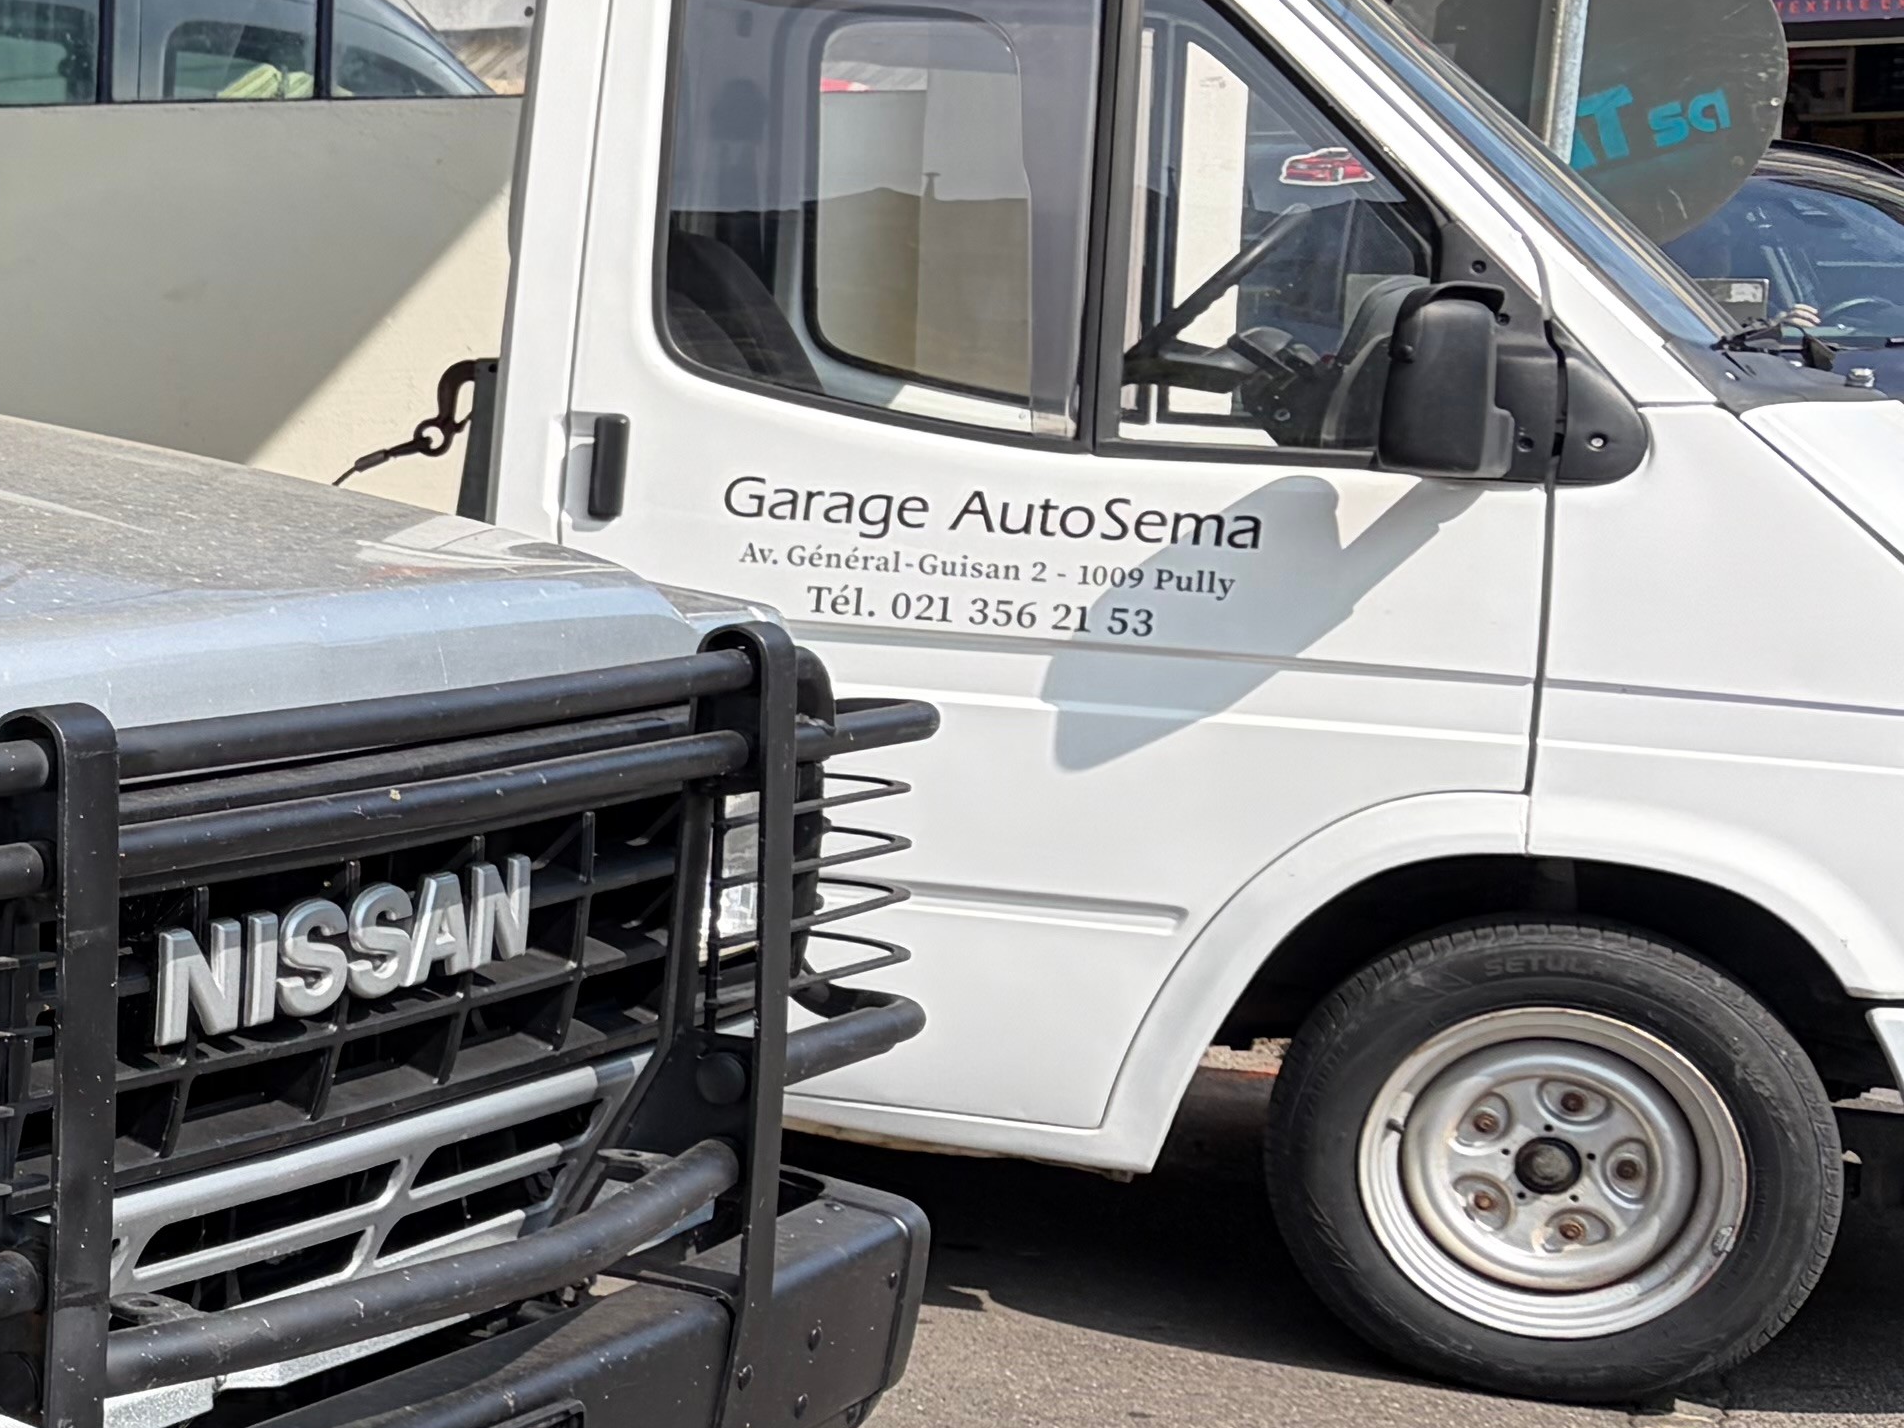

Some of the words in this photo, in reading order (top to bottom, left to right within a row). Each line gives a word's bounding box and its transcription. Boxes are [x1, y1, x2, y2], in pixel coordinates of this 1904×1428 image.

[723, 476, 930, 540] Garage
[948, 489, 1263, 551] AutoSema
[738, 541, 779, 567] Av.
[786, 544, 1021, 582] Général-Guisan
[1031, 560, 1048, 583] 2
[1078, 564, 1144, 590] 1009
[1153, 568, 1236, 601] Pully
[807, 585, 876, 617] Tél.
[891, 592, 952, 623] 021
[968, 598, 1037, 630] 356
[1051, 603, 1092, 633] 21
[1106, 607, 1154, 637] 53
[153, 853, 532, 1047] NISSAN
